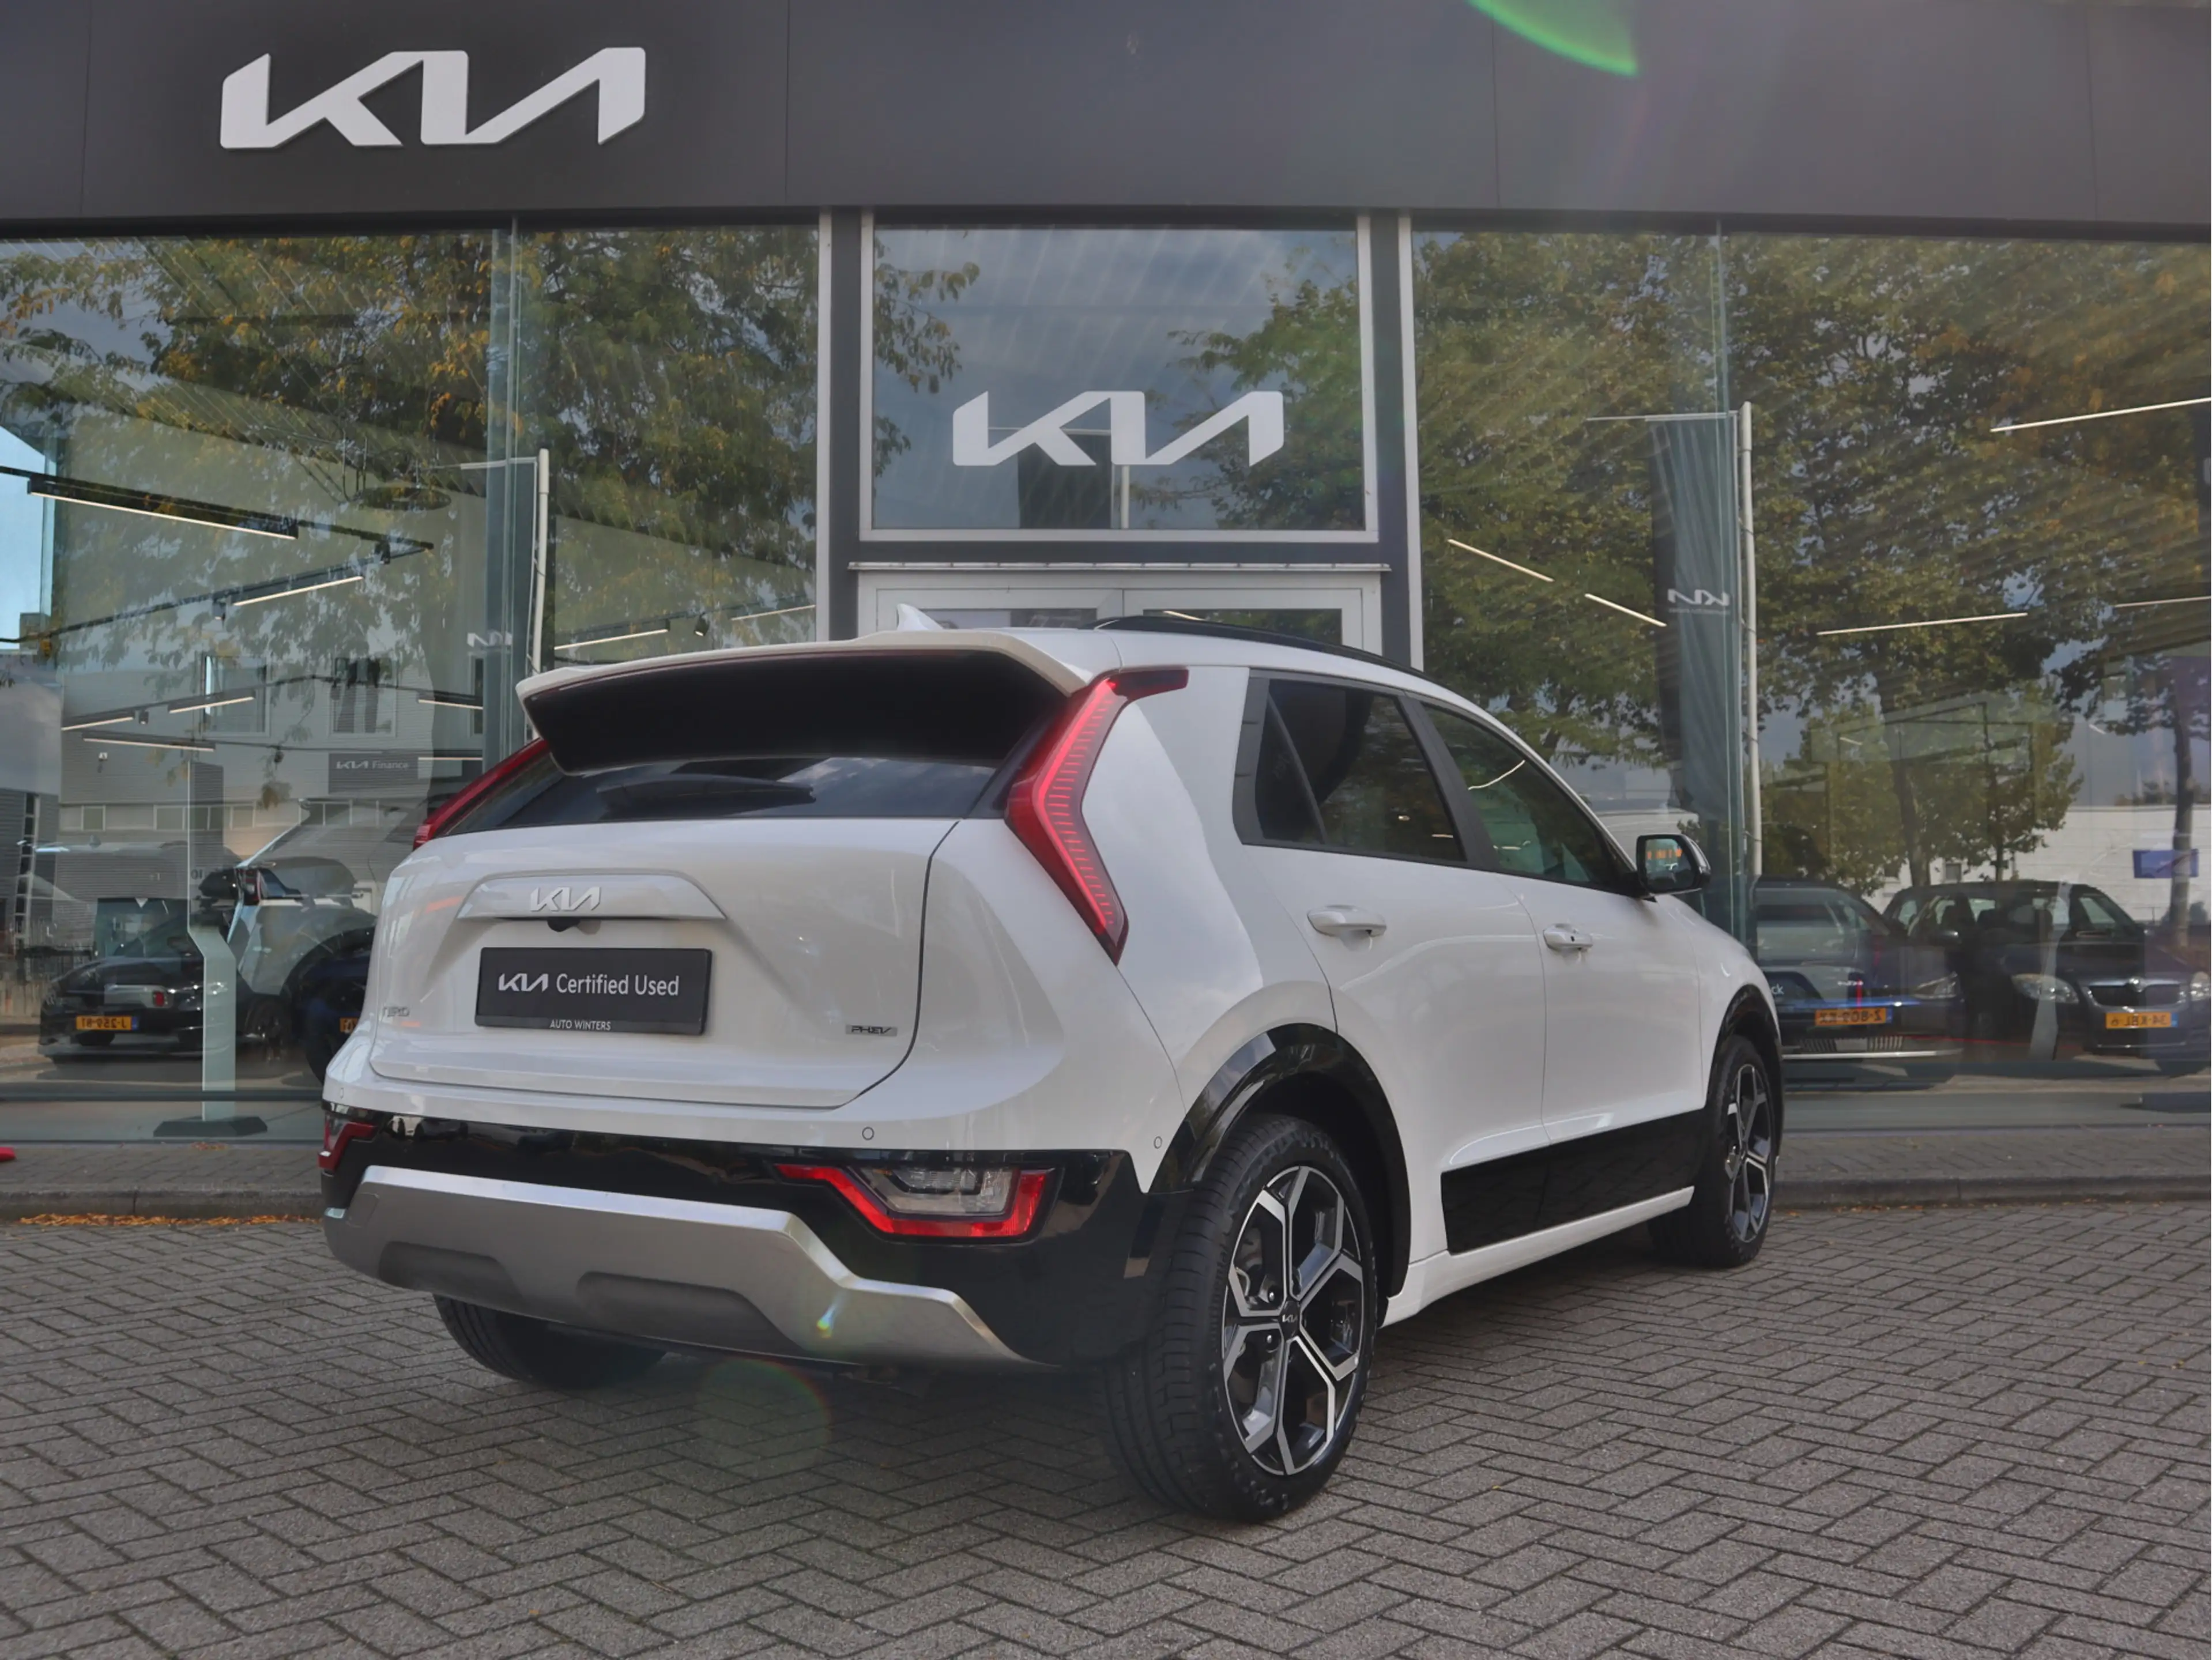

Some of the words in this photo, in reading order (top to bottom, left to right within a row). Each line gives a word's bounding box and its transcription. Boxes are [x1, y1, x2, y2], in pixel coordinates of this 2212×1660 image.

[220, 47, 646, 148] KIA
[953, 391, 1284, 466] KIA
[336, 761, 368, 769] KIA
[372, 760, 408, 769] Finance
[530, 886, 601, 912] KIA
[499, 973, 548, 992] KIA
[556, 973, 629, 995] Certified
[635, 975, 679, 996] Used
[549, 1019, 572, 1029] AUTO
[575, 1020, 611, 1031] WINTERS
